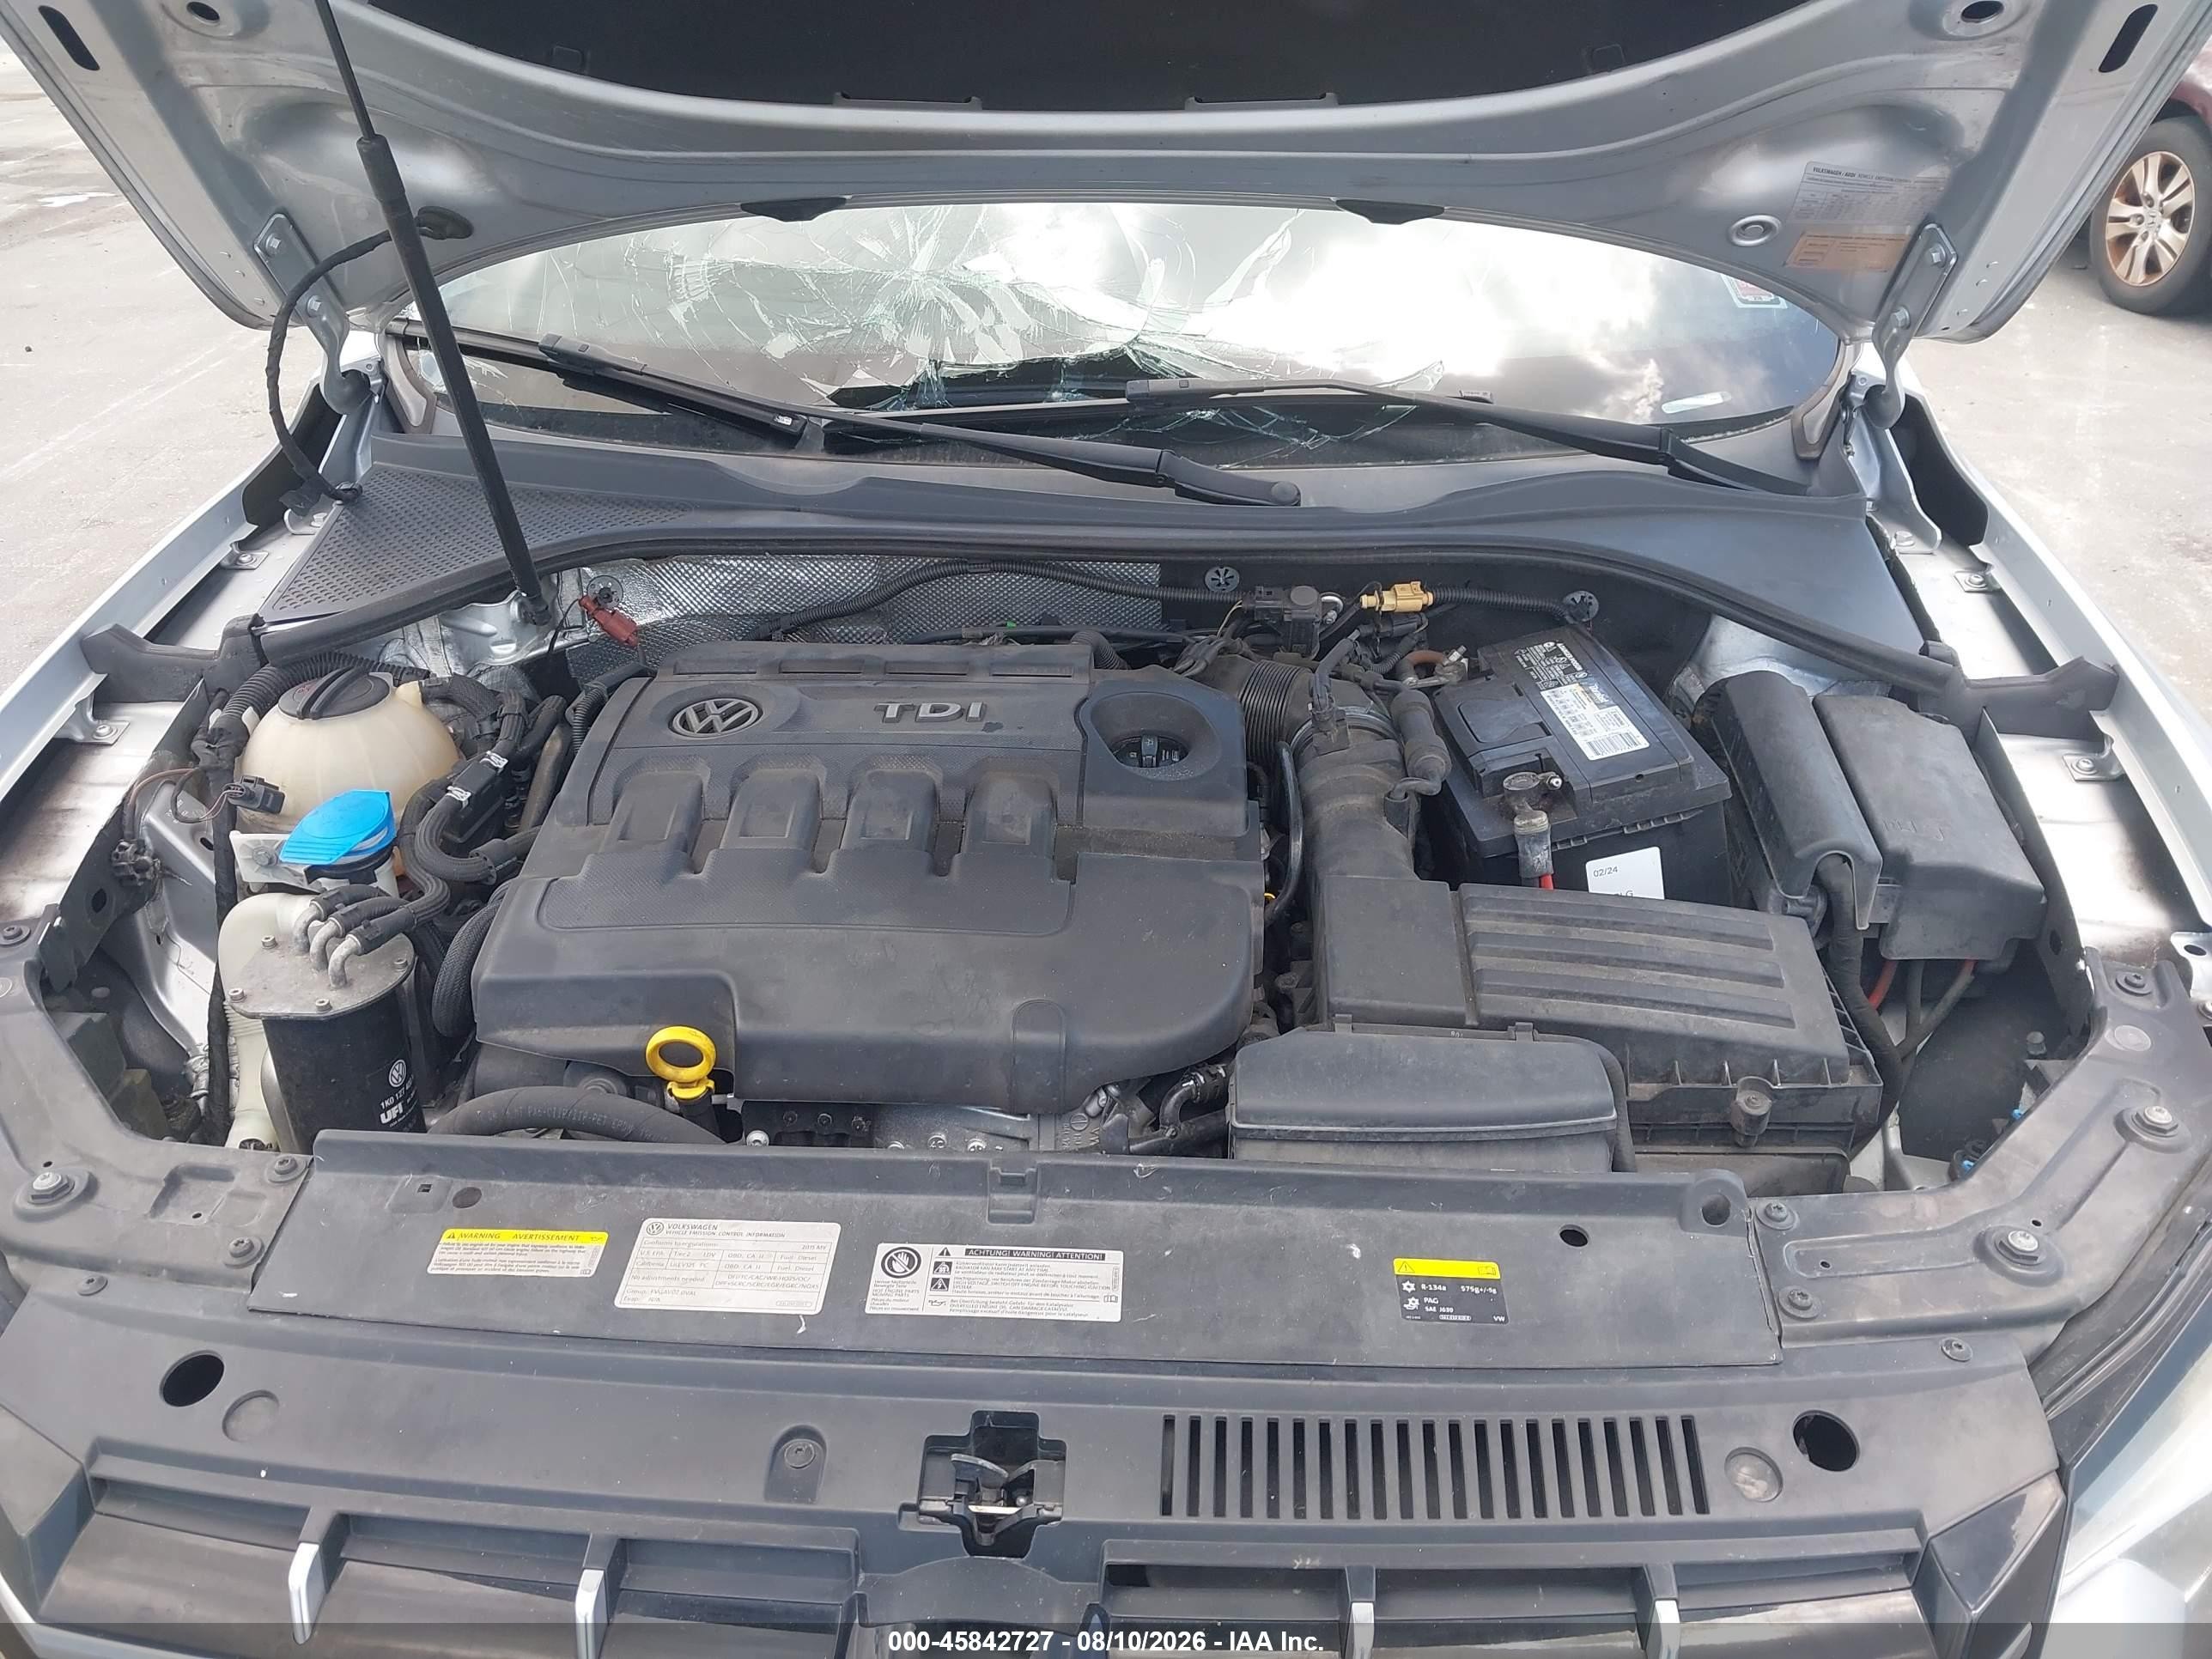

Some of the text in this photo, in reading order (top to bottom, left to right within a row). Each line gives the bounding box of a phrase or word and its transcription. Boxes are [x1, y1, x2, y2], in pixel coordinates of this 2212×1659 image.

[874, 701, 987, 723] TDI
[1594, 866, 1618, 878] 02/24
[380, 1101, 404, 1123] UFI
[1420, 1283, 1498, 1295] R-134a 575g+/-5g
